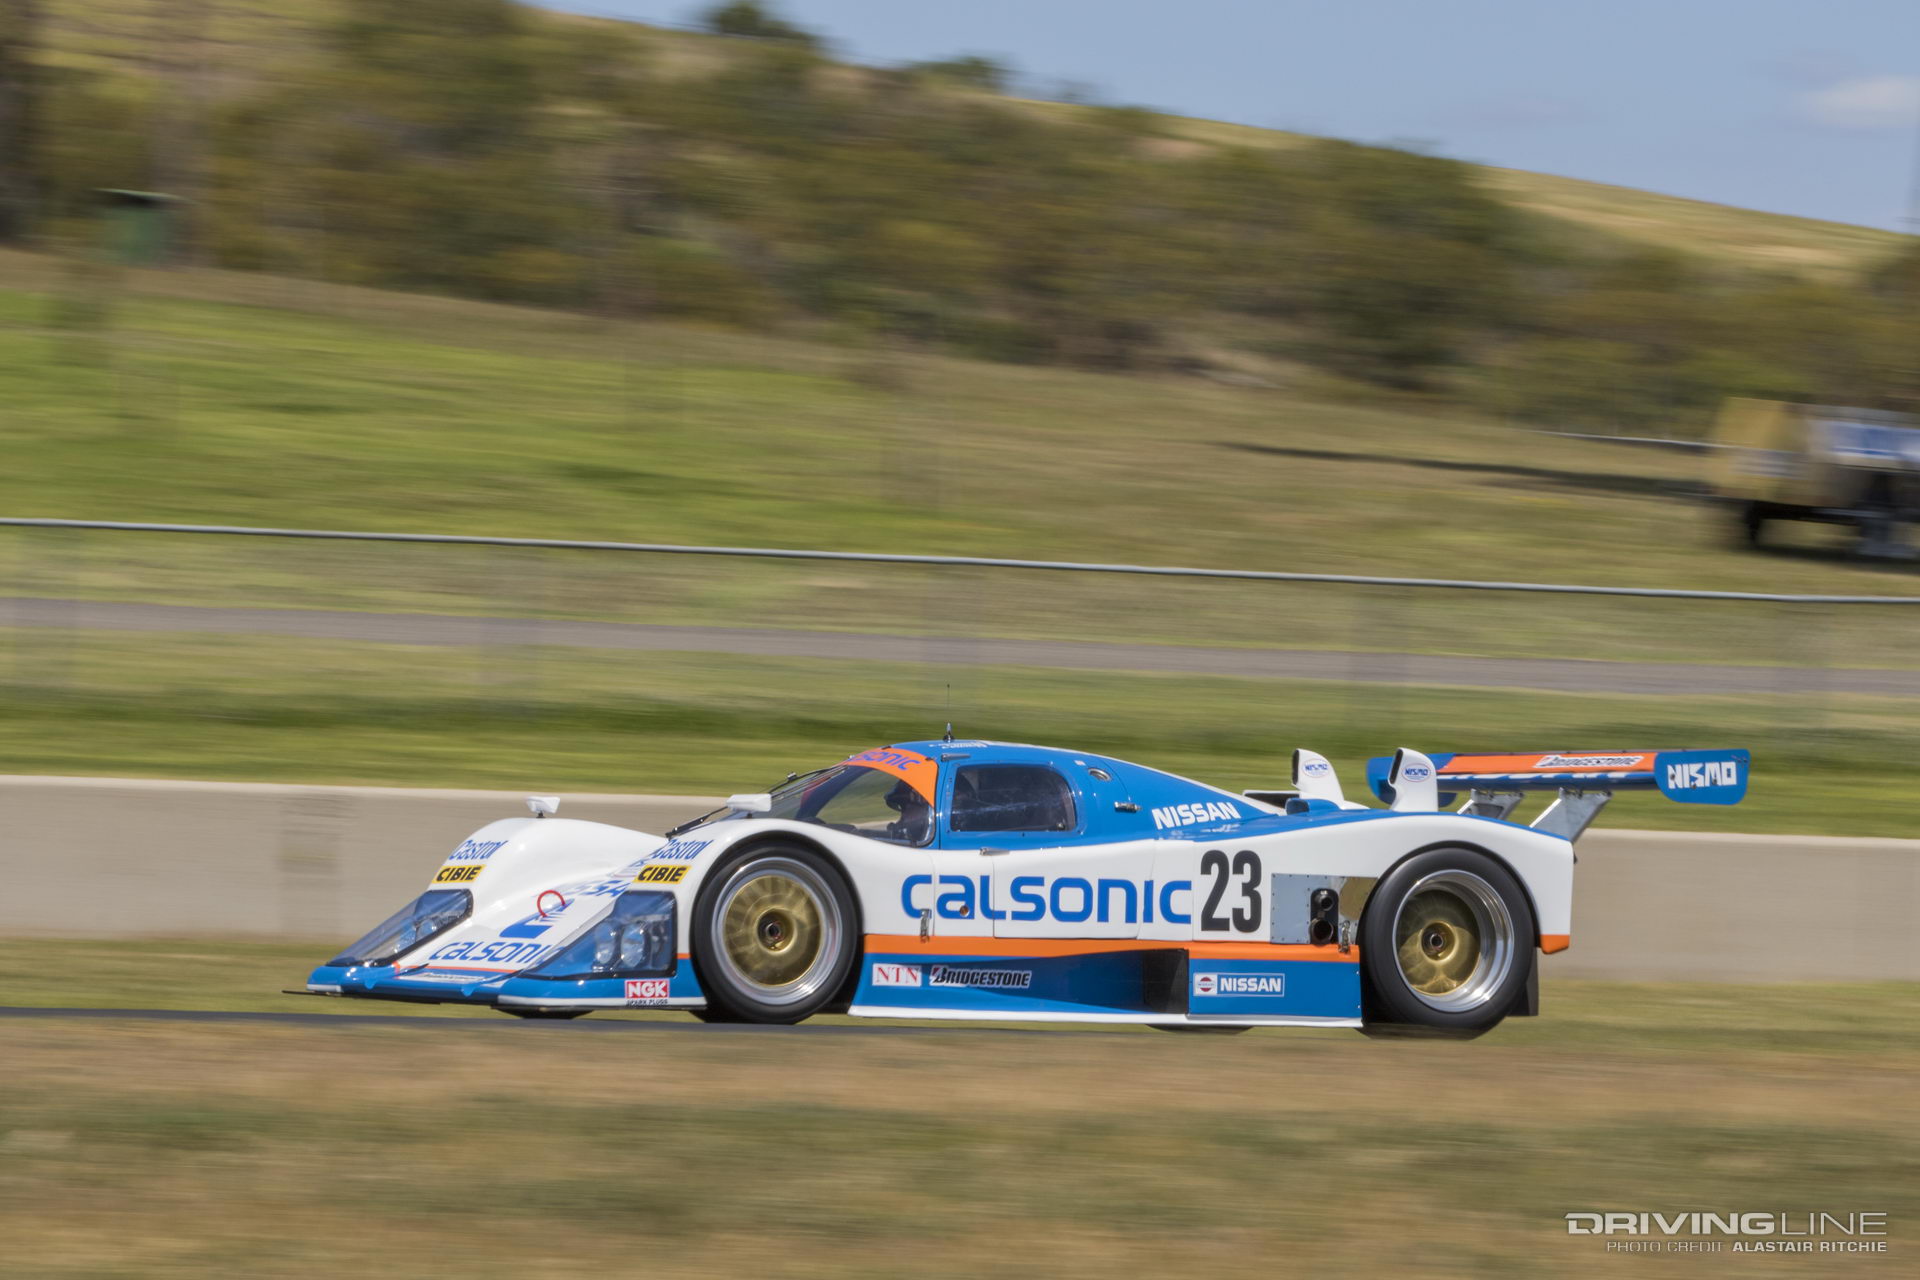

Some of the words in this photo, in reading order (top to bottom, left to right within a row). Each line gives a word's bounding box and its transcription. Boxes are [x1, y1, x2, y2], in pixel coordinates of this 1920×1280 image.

[1404, 768, 1429, 776] NISMO
[1667, 762, 1737, 789] NISMO
[1151, 802, 1242, 830] NISSAN
[448, 839, 508, 860] Castrol
[651, 839, 714, 859] Castrol
[436, 866, 482, 881] CIBIE
[638, 866, 687, 881] CIBIE
[1200, 850, 1262, 933] 23
[876, 967, 920, 983] NTN
[931, 967, 1030, 987] BRIDGESTONE
[628, 981, 667, 997] NGK
[1220, 977, 1281, 992] NISSAN
